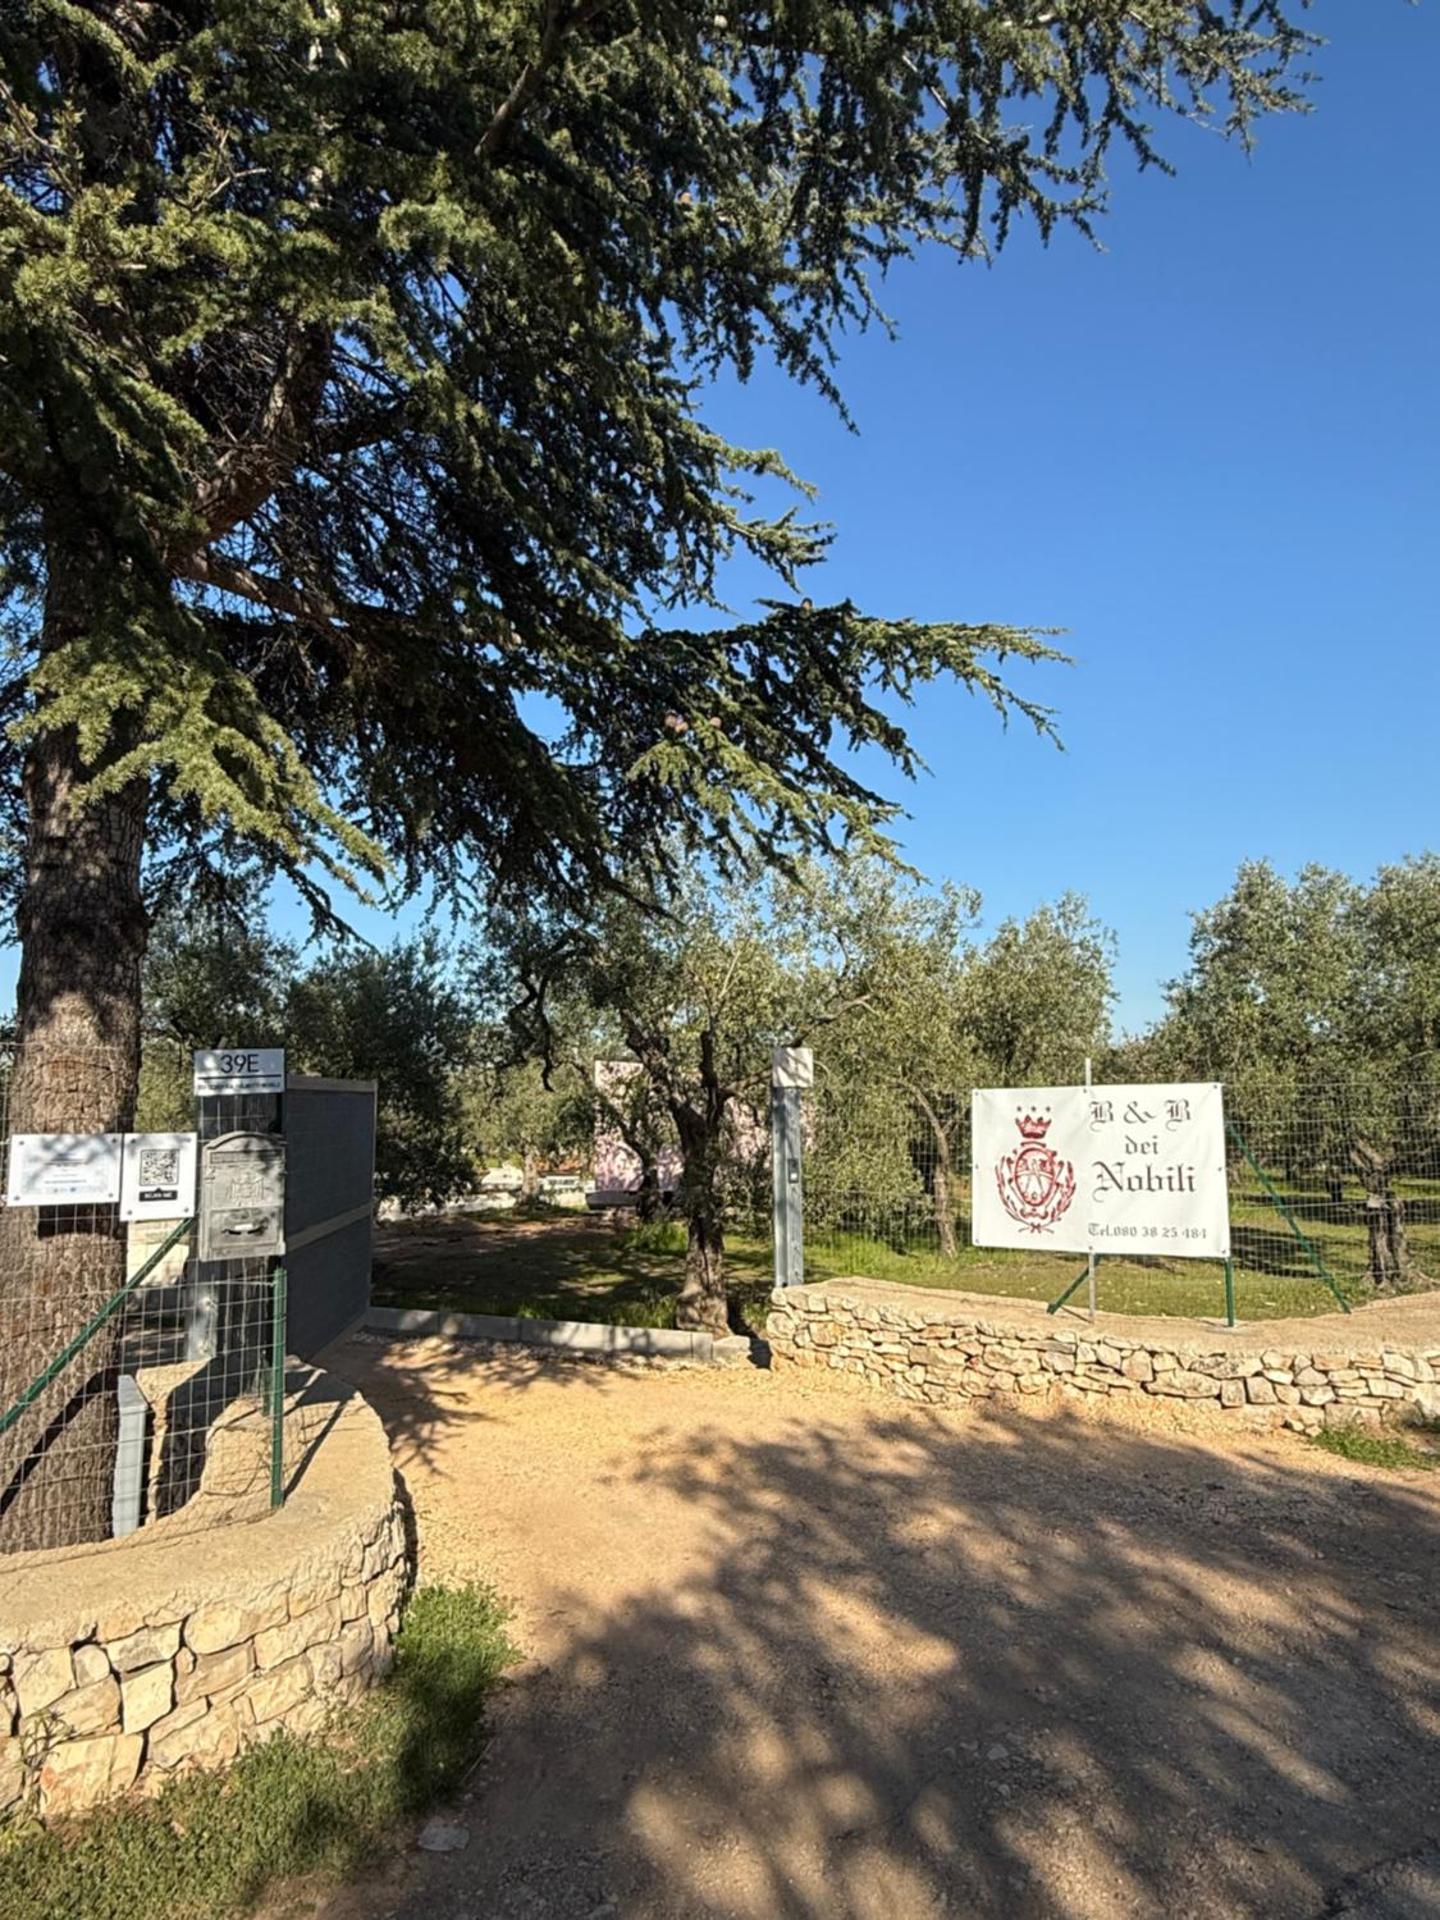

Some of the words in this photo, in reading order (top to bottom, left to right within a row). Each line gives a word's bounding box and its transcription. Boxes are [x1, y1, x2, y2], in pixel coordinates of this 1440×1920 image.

[220, 1053, 259, 1074] 39E
[1088, 1099, 1114, 1132] B
[1122, 1100, 1156, 1124] &
[1164, 1098, 1191, 1132] B
[1124, 1134, 1159, 1155] dei
[1091, 1160, 1196, 1203] Nobili
[1141, 1226, 1158, 1238] 38
[1161, 1226, 1178, 1239] 25
